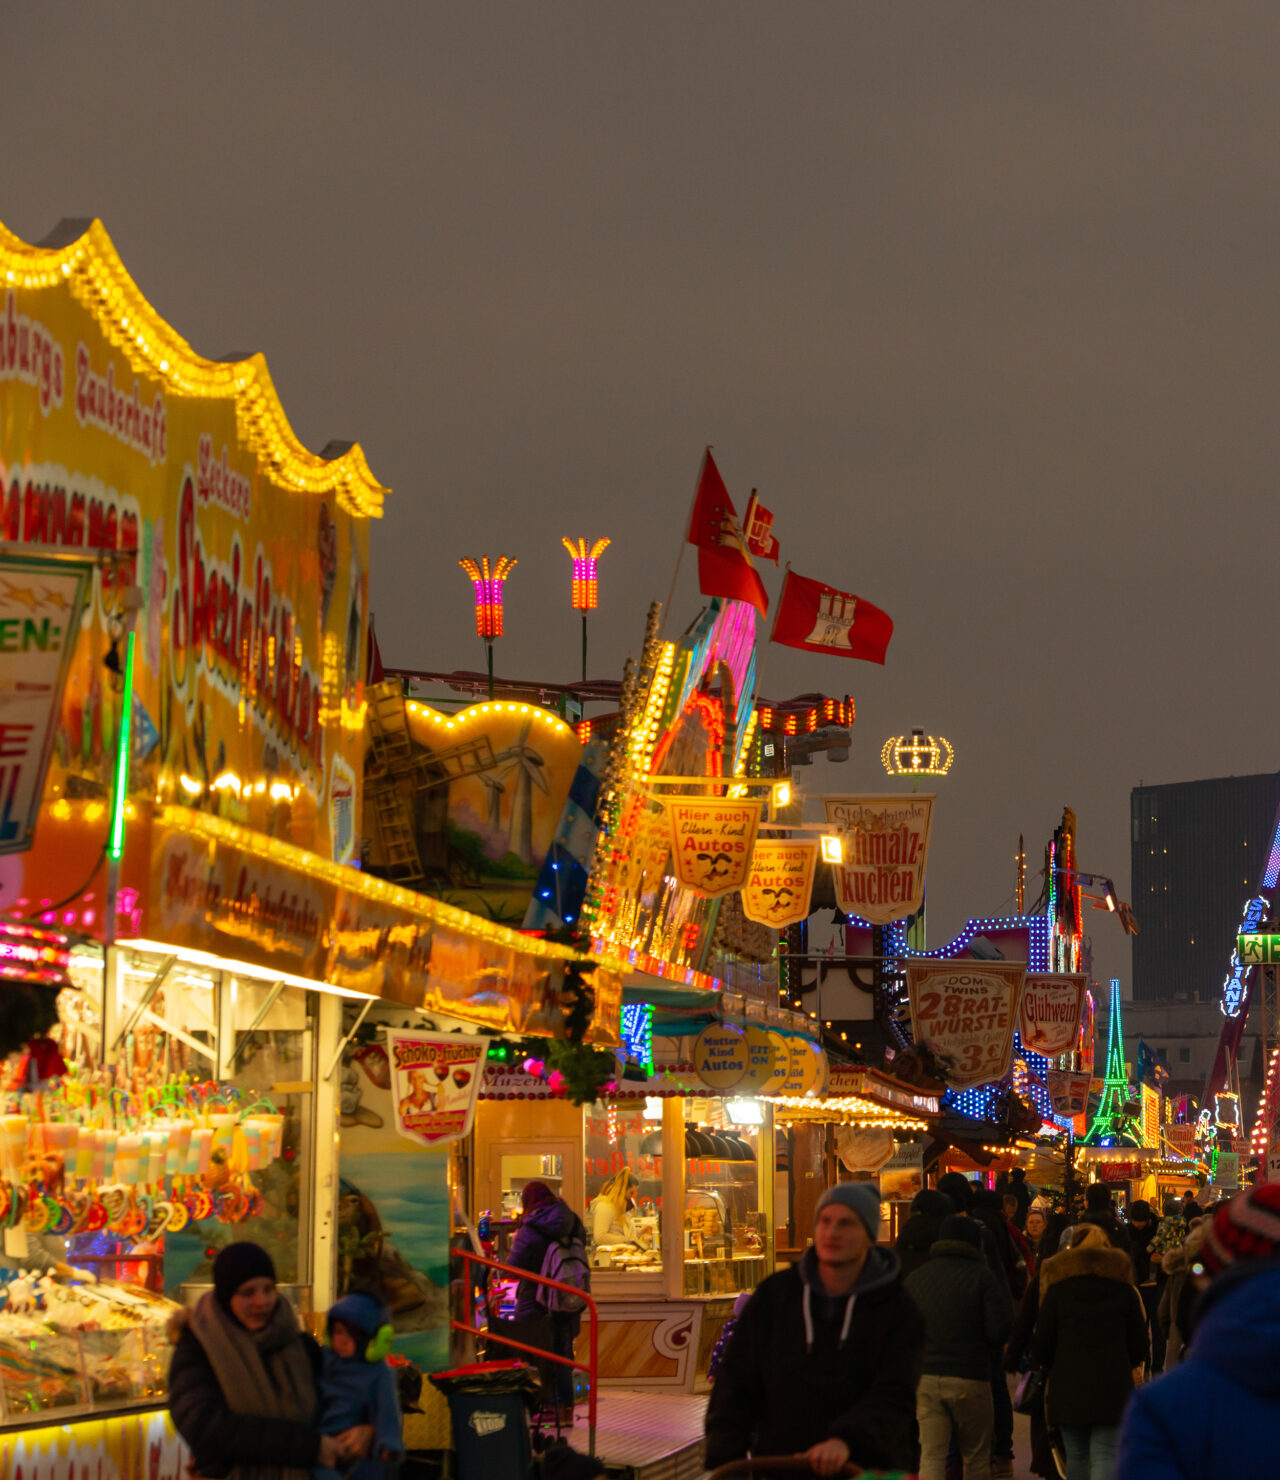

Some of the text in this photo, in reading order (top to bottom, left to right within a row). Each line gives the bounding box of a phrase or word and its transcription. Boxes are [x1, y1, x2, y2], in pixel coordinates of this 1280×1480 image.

[76, 345, 166, 463] Zauberhaft
[679, 809, 750, 822] Hier auch
[684, 837, 745, 852] Autos
[753, 851, 807, 860] ier auch
[750, 874, 804, 887] Autos
[841, 866, 914, 905] kuchen
[949, 976, 984, 986] DOM
[944, 986, 988, 995] TWINS
[1025, 993, 1077, 1023] Glühwein
[929, 1009, 1008, 1037] WÜRSTE
[709, 1048, 735, 1057] Kind
[702, 1059, 743, 1072] Autos
[482, 1073, 552, 1088] Muzen
[830, 1078, 859, 1087] chen
